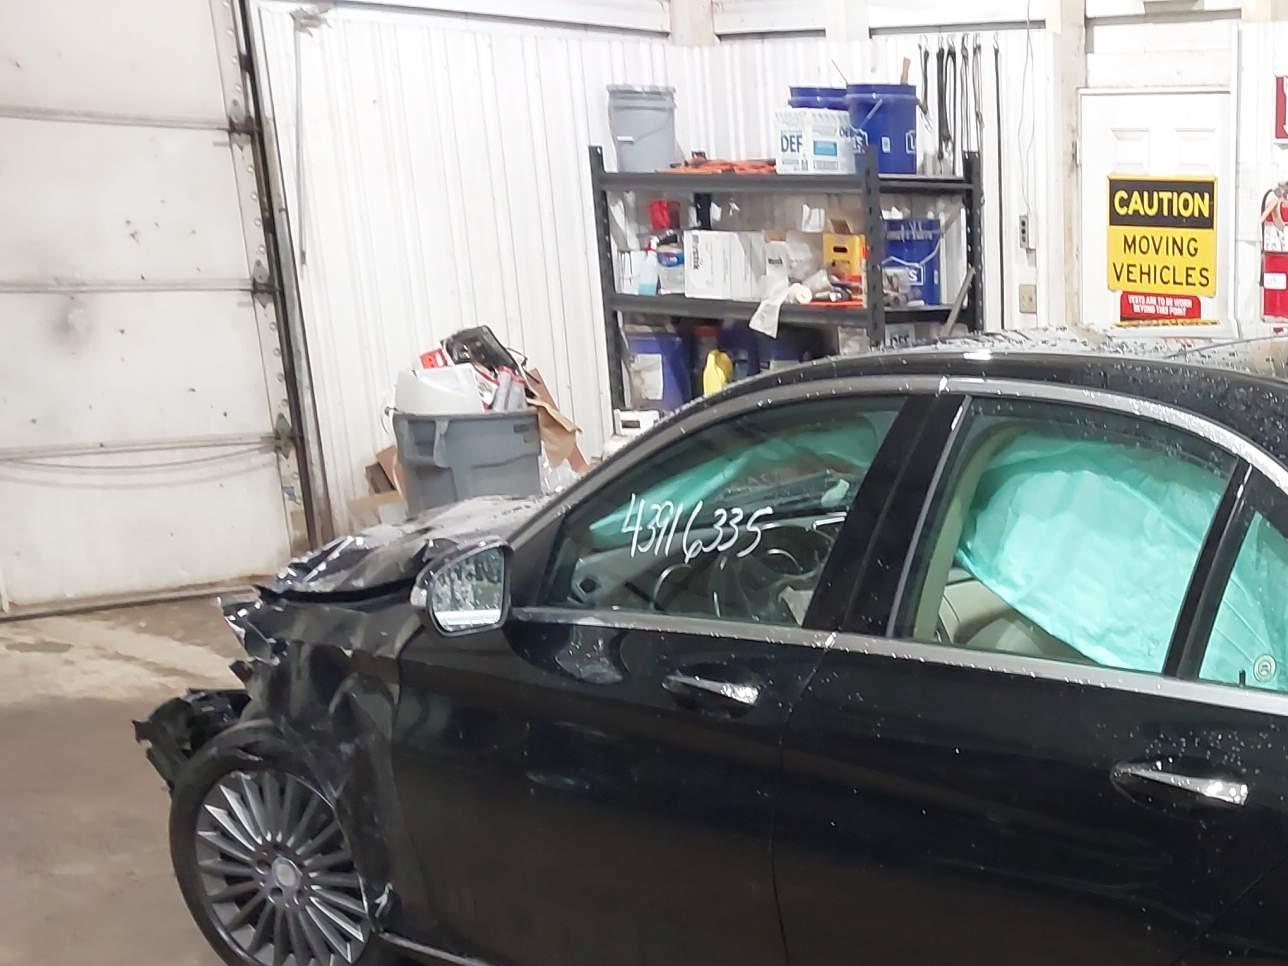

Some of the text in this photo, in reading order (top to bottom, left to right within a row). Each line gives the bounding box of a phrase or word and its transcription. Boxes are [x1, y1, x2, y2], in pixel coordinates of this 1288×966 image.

[780, 134, 803, 153] DEF
[1114, 190, 1210, 218] CAUTION
[1123, 234, 1199, 257] MOVING
[1112, 262, 1210, 287] VEHICLES
[620, 493, 774, 564] 43916335
